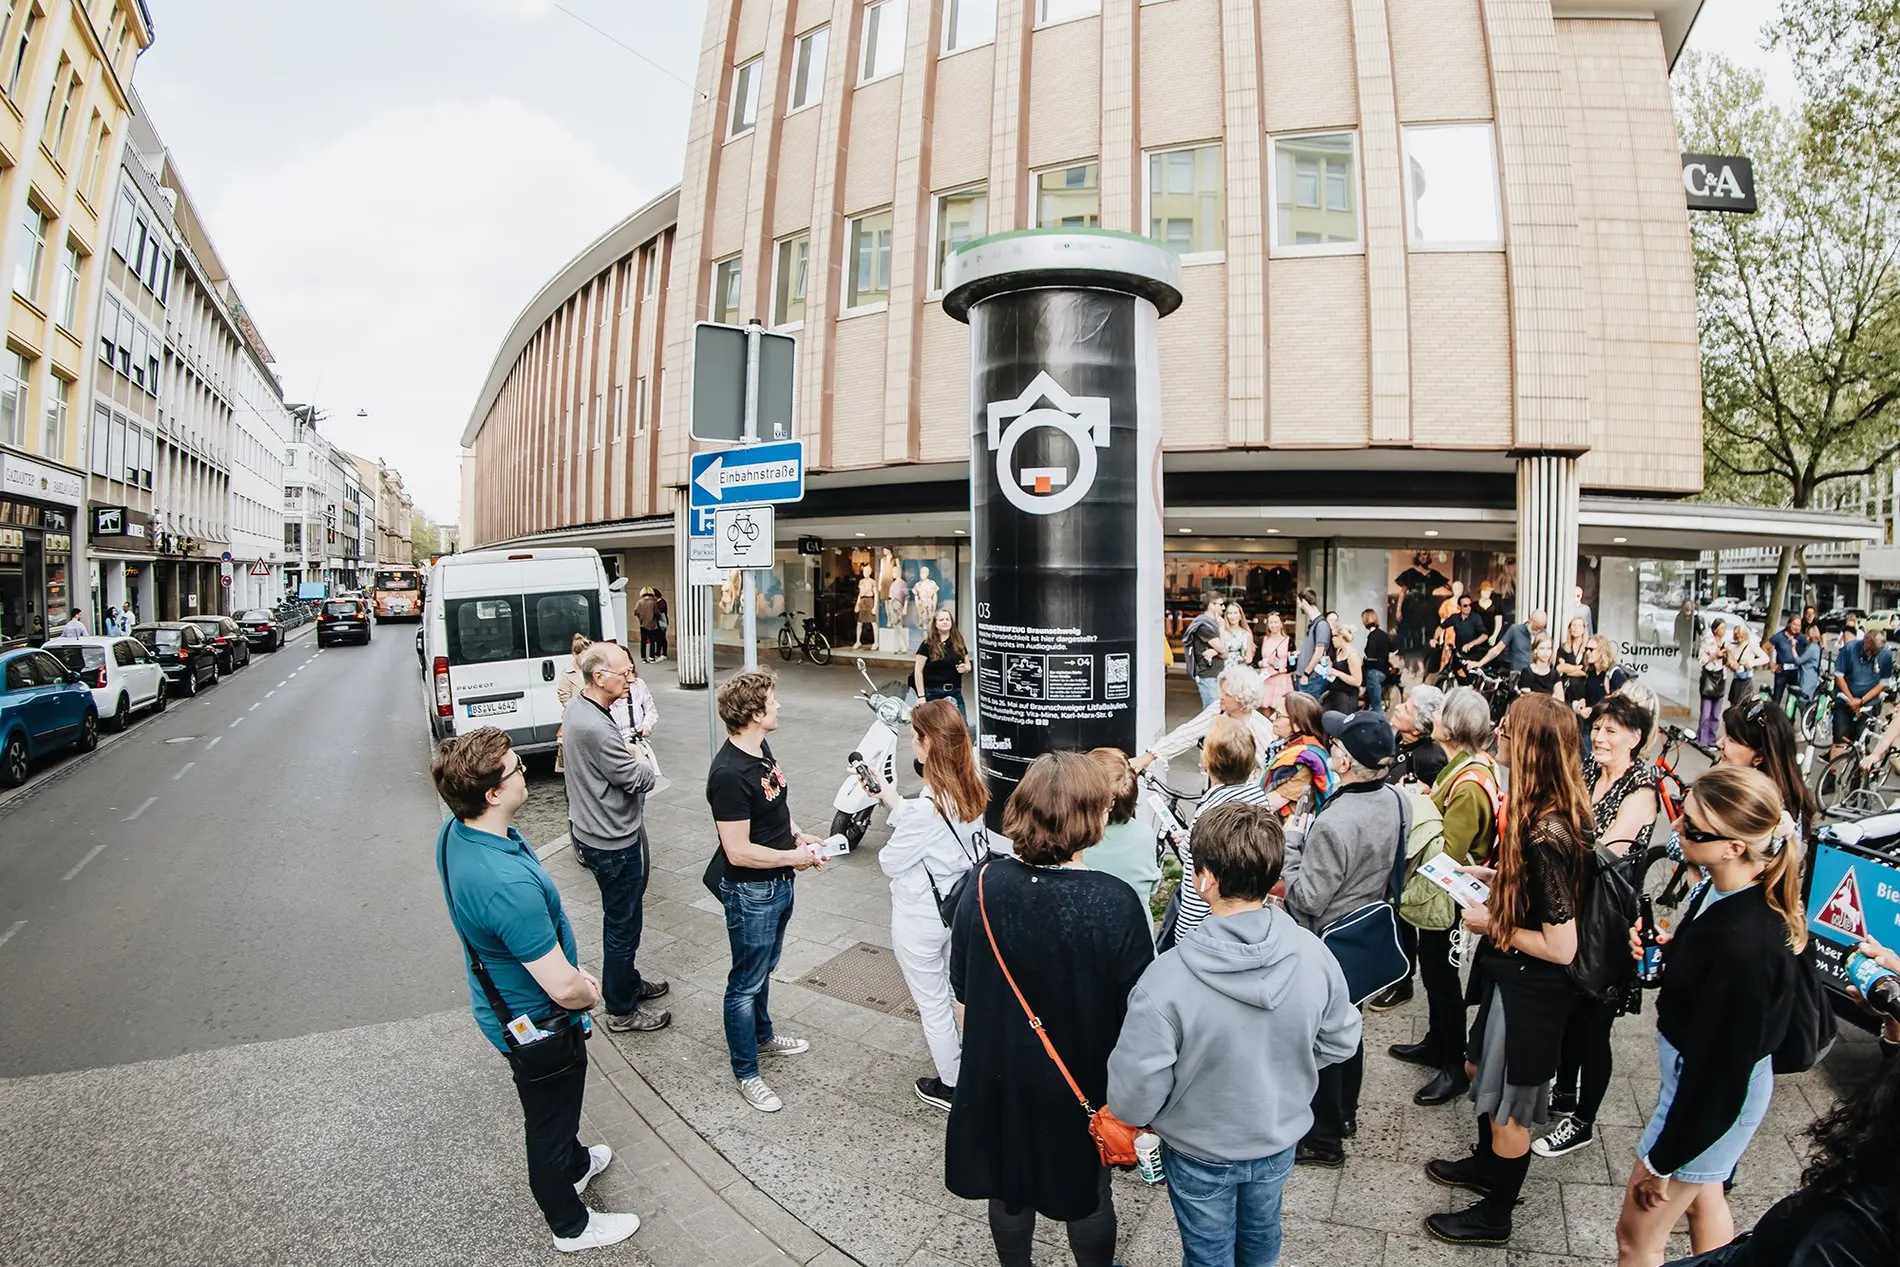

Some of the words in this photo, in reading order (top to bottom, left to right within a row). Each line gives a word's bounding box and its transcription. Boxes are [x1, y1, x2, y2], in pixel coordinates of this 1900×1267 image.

[1683, 163, 1745, 198] C&A
[720, 465, 794, 484] Einbahnstraße
[978, 602, 991, 619] 03
[1027, 627, 1081, 636] Braunschweig
[992, 632, 1030, 641] Persönlichkeit
[1056, 635, 1098, 644] dargestellt?
[1026, 643, 1068, 651] Audioguide.
[1621, 642, 1680, 658] Summer
[1077, 658, 1090, 666] 04
[456, 682, 494, 690] PEUGEOT
[1030, 703, 1086, 712] Braunschweiger
[1026, 711, 1060, 719] Vita-Mine,
[1060, 711, 1107, 719] Karl-Marx-Str.
[1876, 881, 1900, 904] Bie
